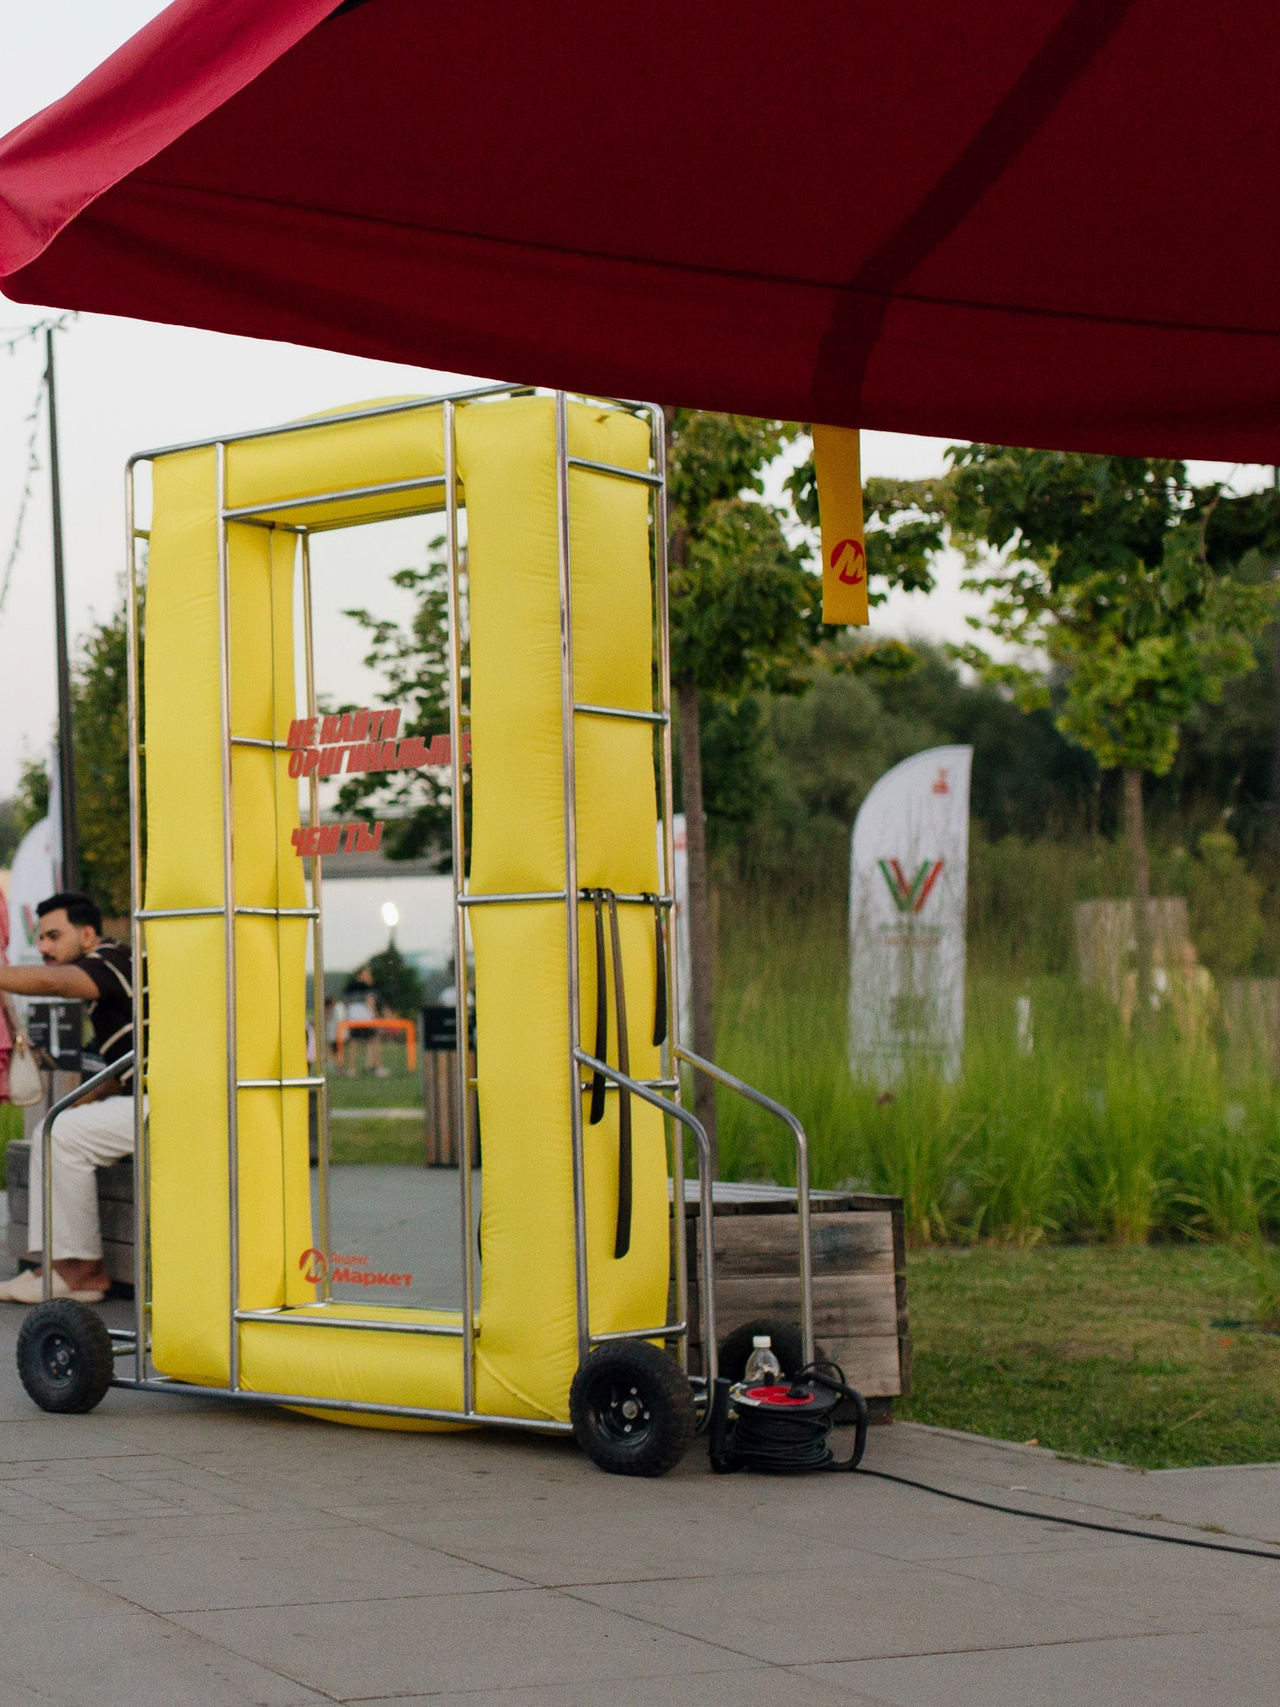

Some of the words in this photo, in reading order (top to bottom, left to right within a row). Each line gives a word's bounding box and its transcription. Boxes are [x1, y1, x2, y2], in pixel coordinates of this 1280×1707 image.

[288, 719, 317, 748] НЕ
[320, 707, 401, 744] НАЙТИ
[291, 826, 340, 857] ЧЕМ
[345, 822, 384, 853] ТЫ
[331, 1268, 412, 1287] Маркет
